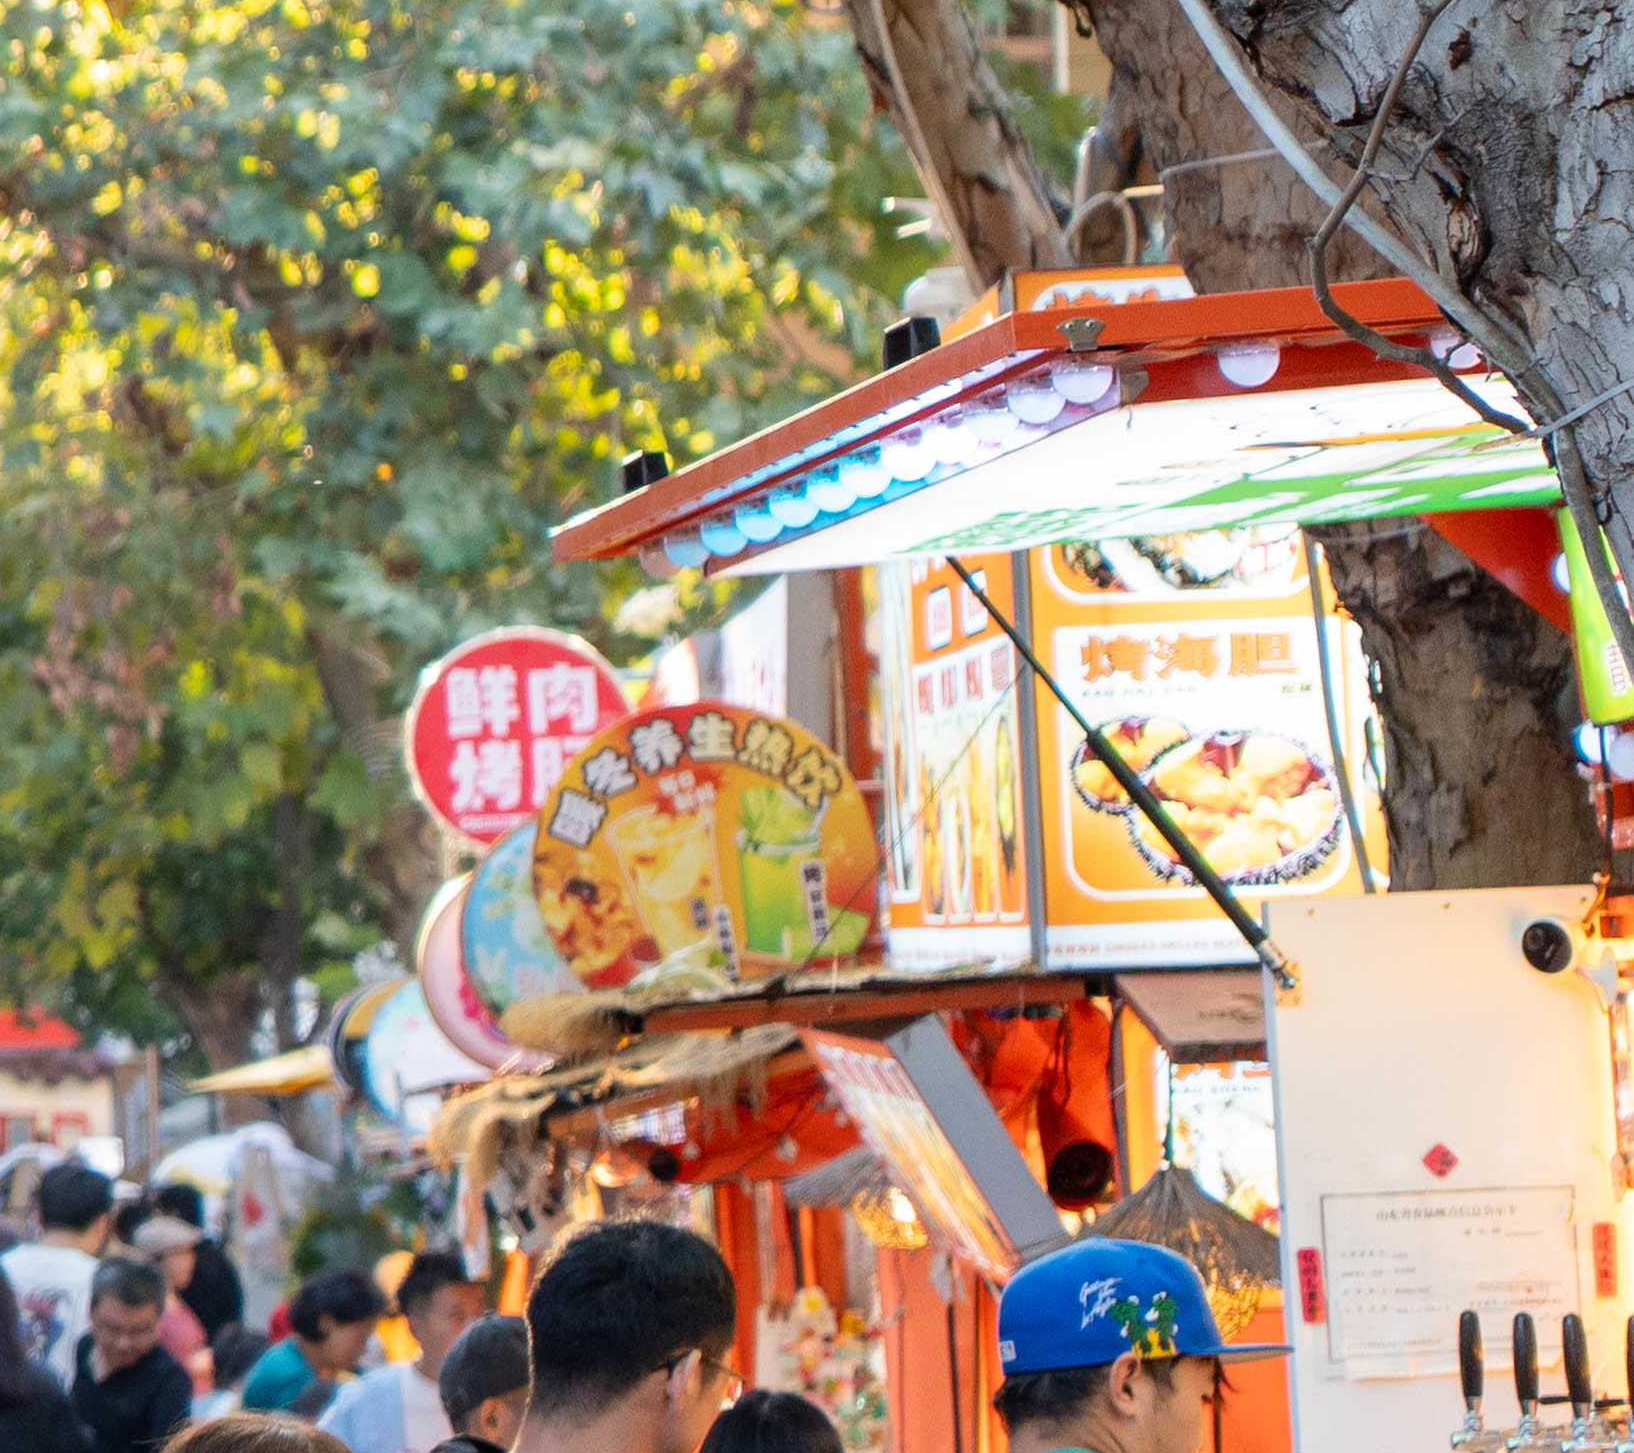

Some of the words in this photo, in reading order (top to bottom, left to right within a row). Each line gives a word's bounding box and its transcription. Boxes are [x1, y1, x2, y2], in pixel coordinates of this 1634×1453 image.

[1080, 632, 1300, 684] 烤海胆
[445, 665, 598, 738] 鲜肉
